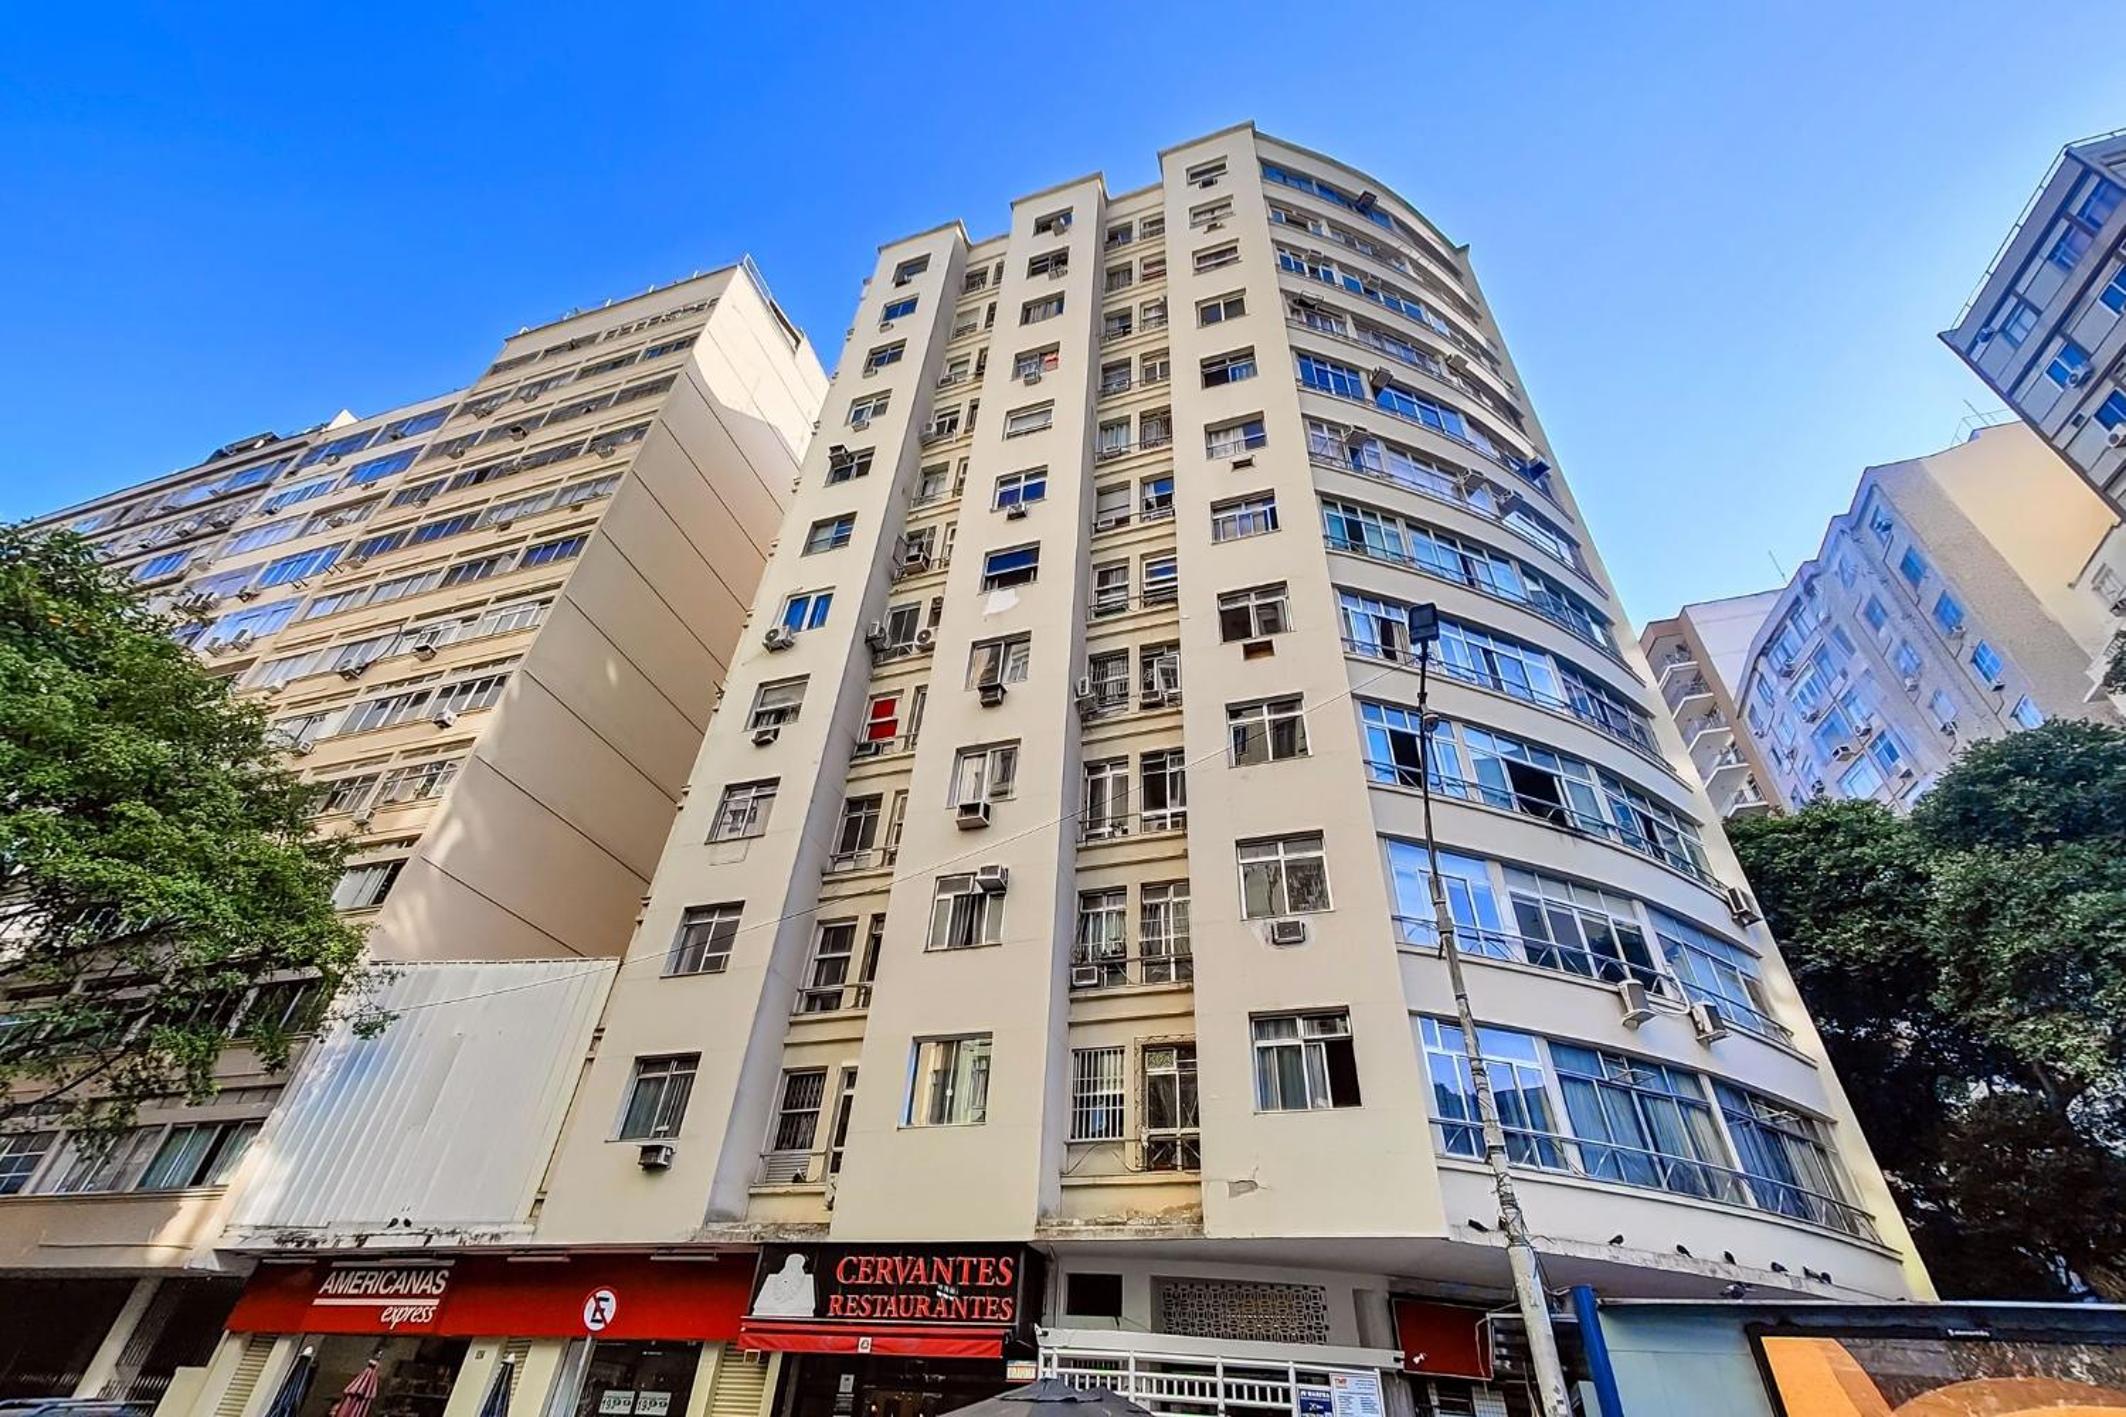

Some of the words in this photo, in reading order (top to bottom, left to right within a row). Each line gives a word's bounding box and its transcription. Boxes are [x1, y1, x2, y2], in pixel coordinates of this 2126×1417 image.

[318, 1269, 449, 1294] AMERICANAS
[836, 1256, 1014, 1286] CERVANTES
[380, 1305, 437, 1330] express
[827, 1294, 1013, 1321] RESTAURANTES
